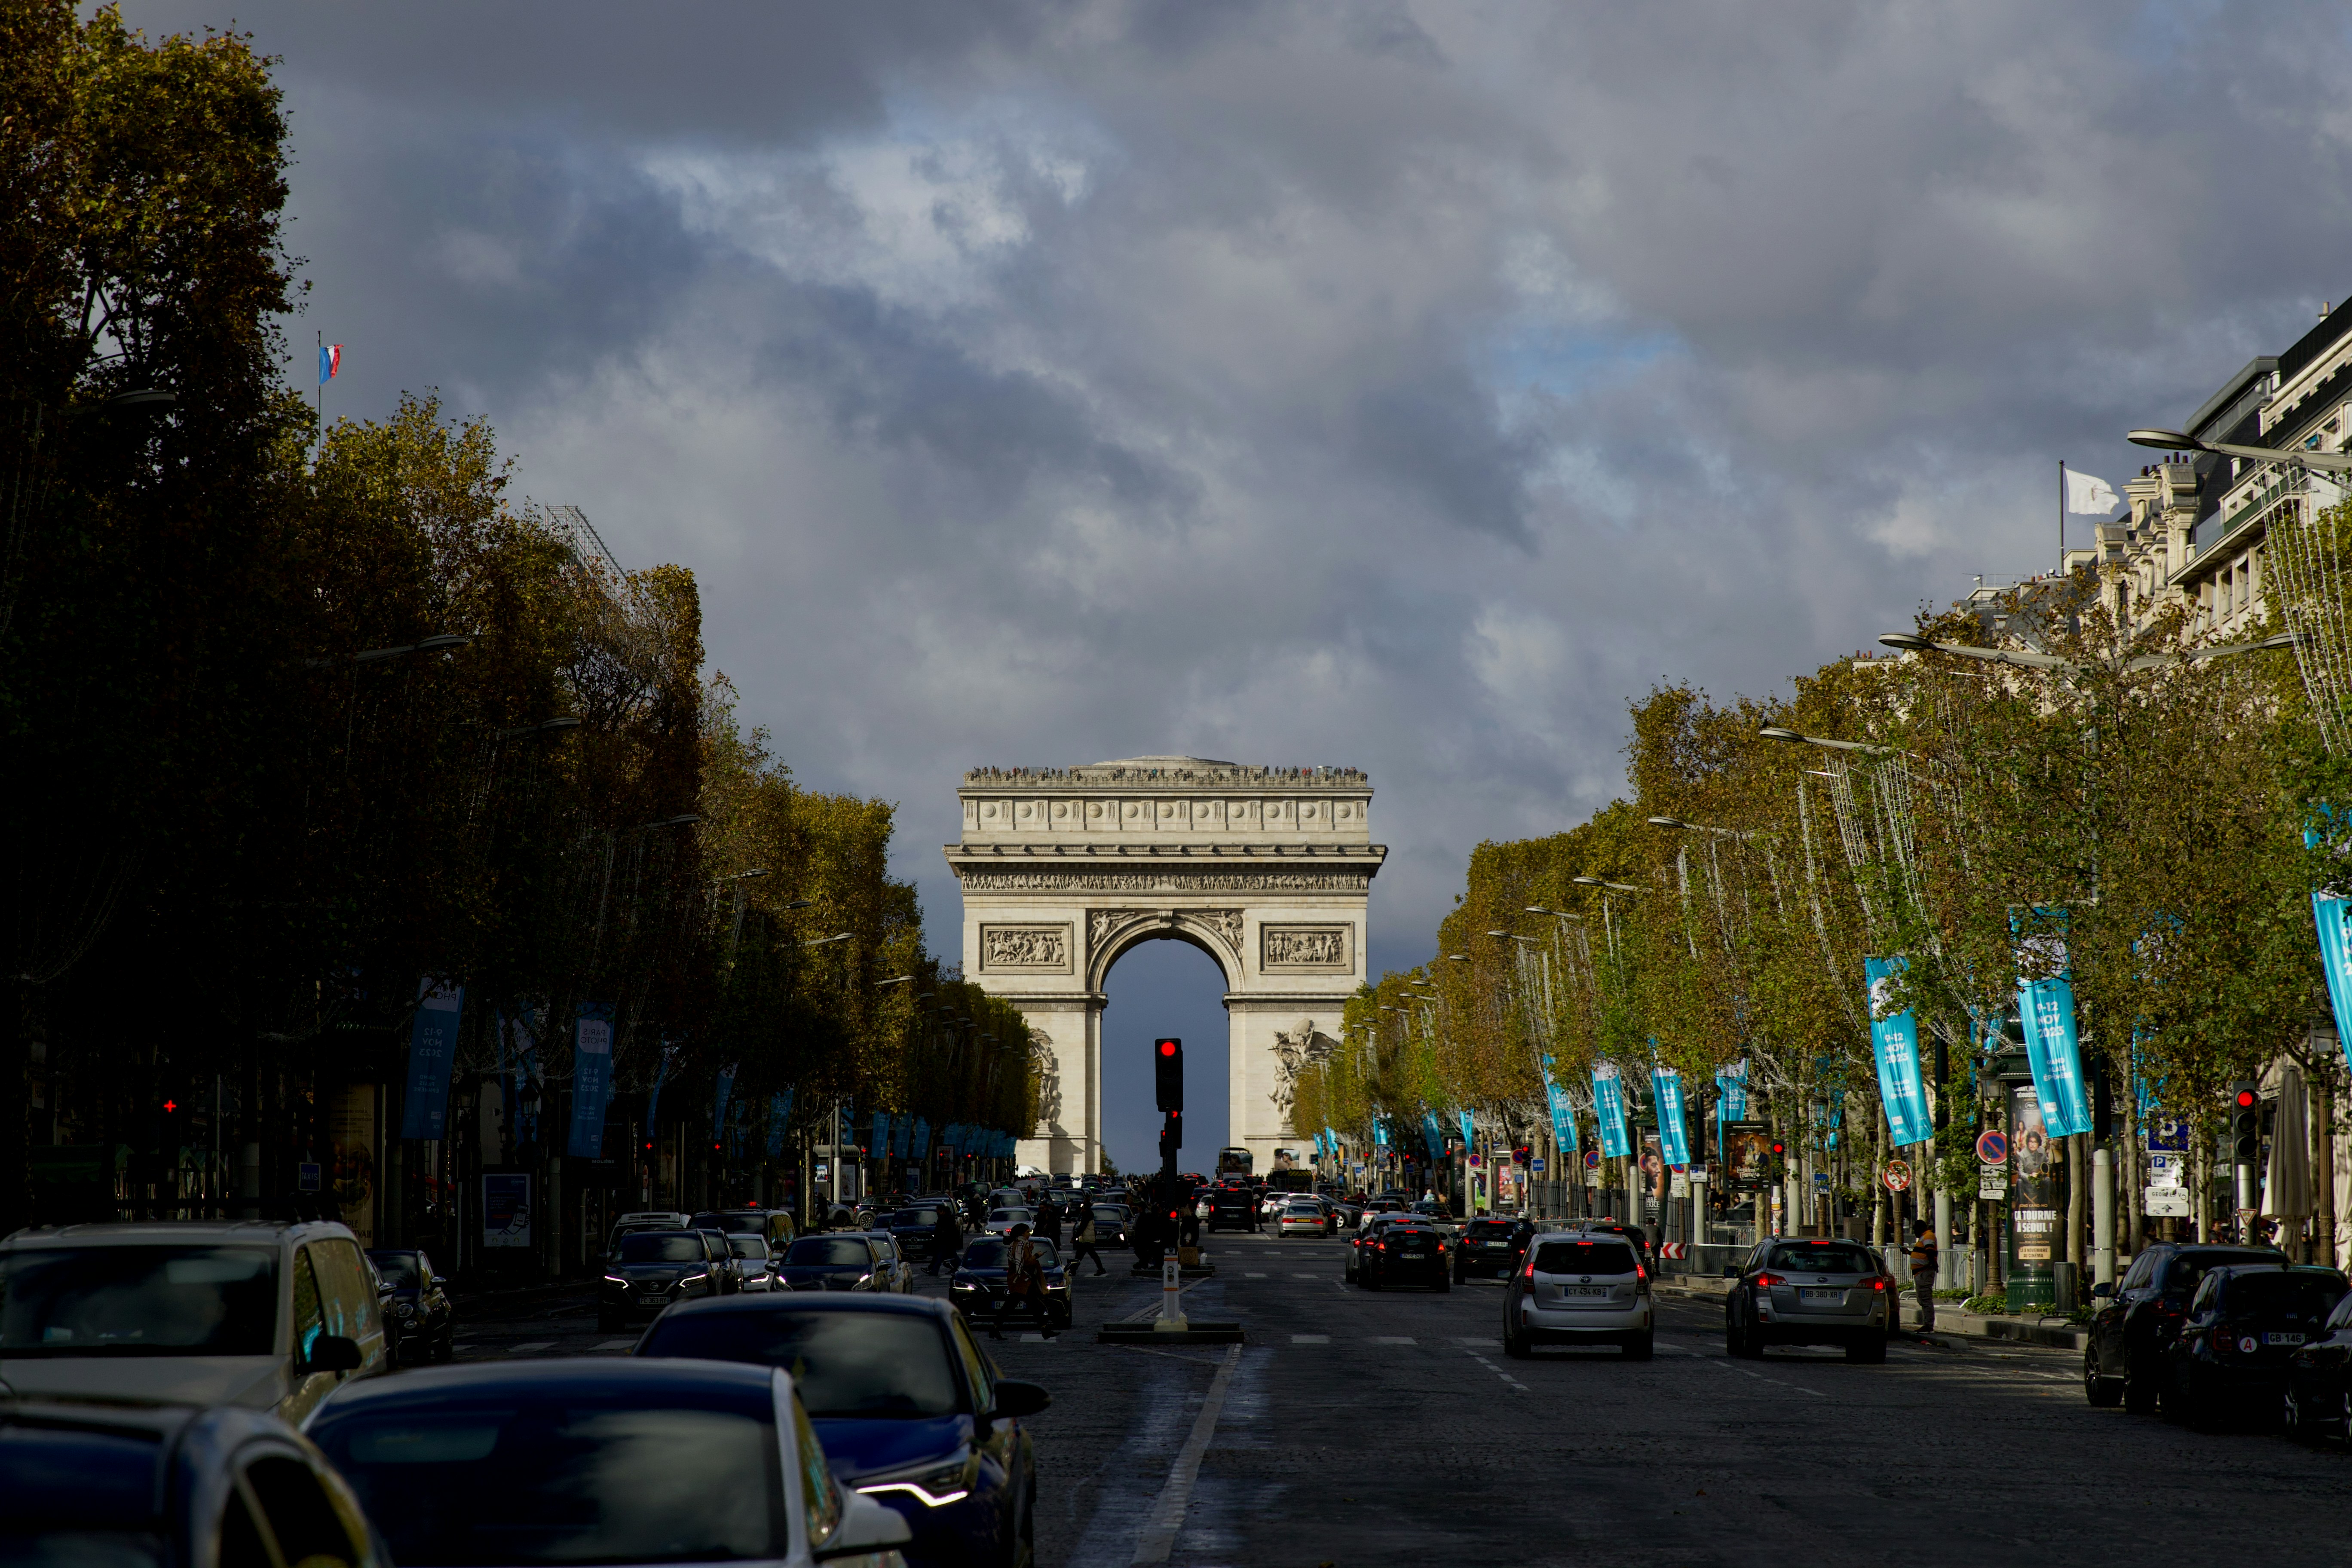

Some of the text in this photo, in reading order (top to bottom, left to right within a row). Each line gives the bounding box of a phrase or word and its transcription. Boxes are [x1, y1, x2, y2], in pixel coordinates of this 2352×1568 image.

[2037, 1013, 2061, 1026] NOV
[2037, 1026, 2064, 1039] 2023
[2156, 1157, 2164, 1167] P
[301, 1172, 318, 1181] TAXIS
[2015, 1210, 2057, 1222] ÇA TOURNE
[2022, 1221, 2047, 1232] SÉOUL
[2243, 1339, 2252, 1351] A
